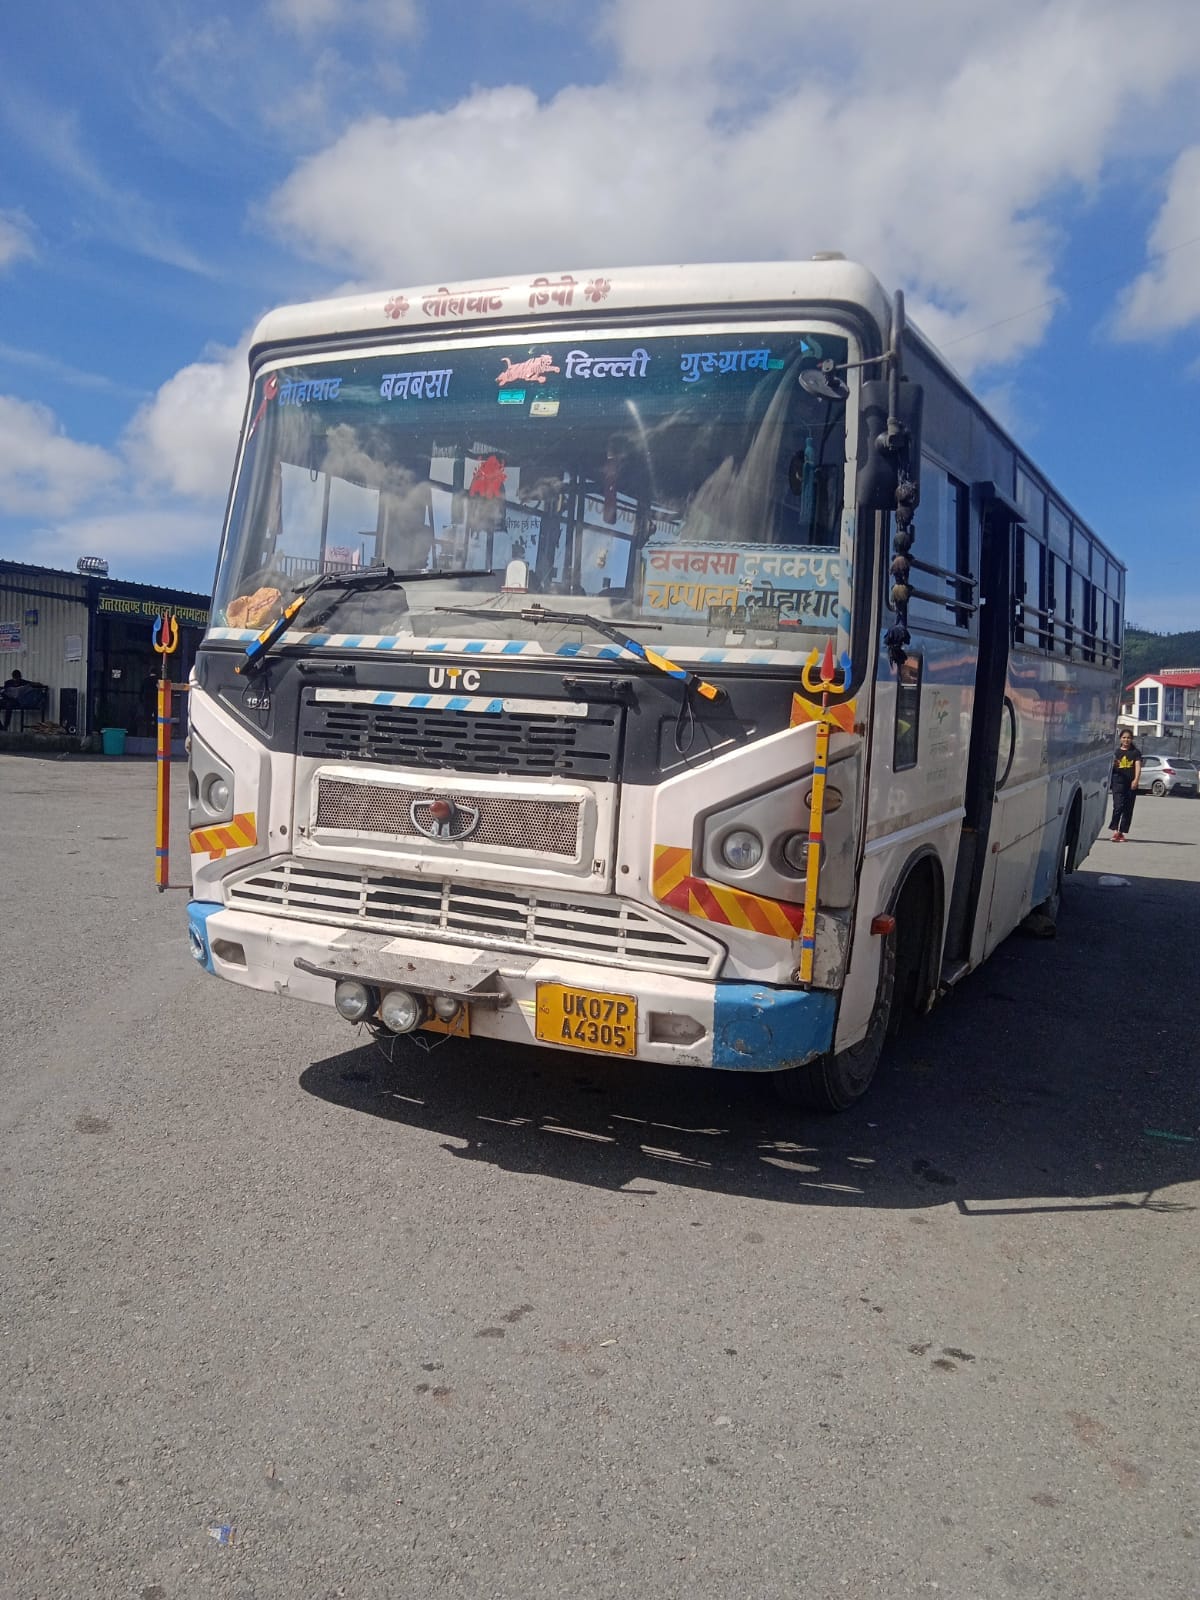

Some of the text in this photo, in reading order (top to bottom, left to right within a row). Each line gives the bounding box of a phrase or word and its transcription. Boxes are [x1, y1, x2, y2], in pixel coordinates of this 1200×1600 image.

[422, 275, 578, 317] लोहाघाट डिपो
[379, 369, 454, 401] बनबसा
[565, 348, 652, 379] दिल्ली
[428, 667, 481, 691] UTC
[562, 991, 629, 1025] UK07P
[561, 1017, 627, 1048] A4305
